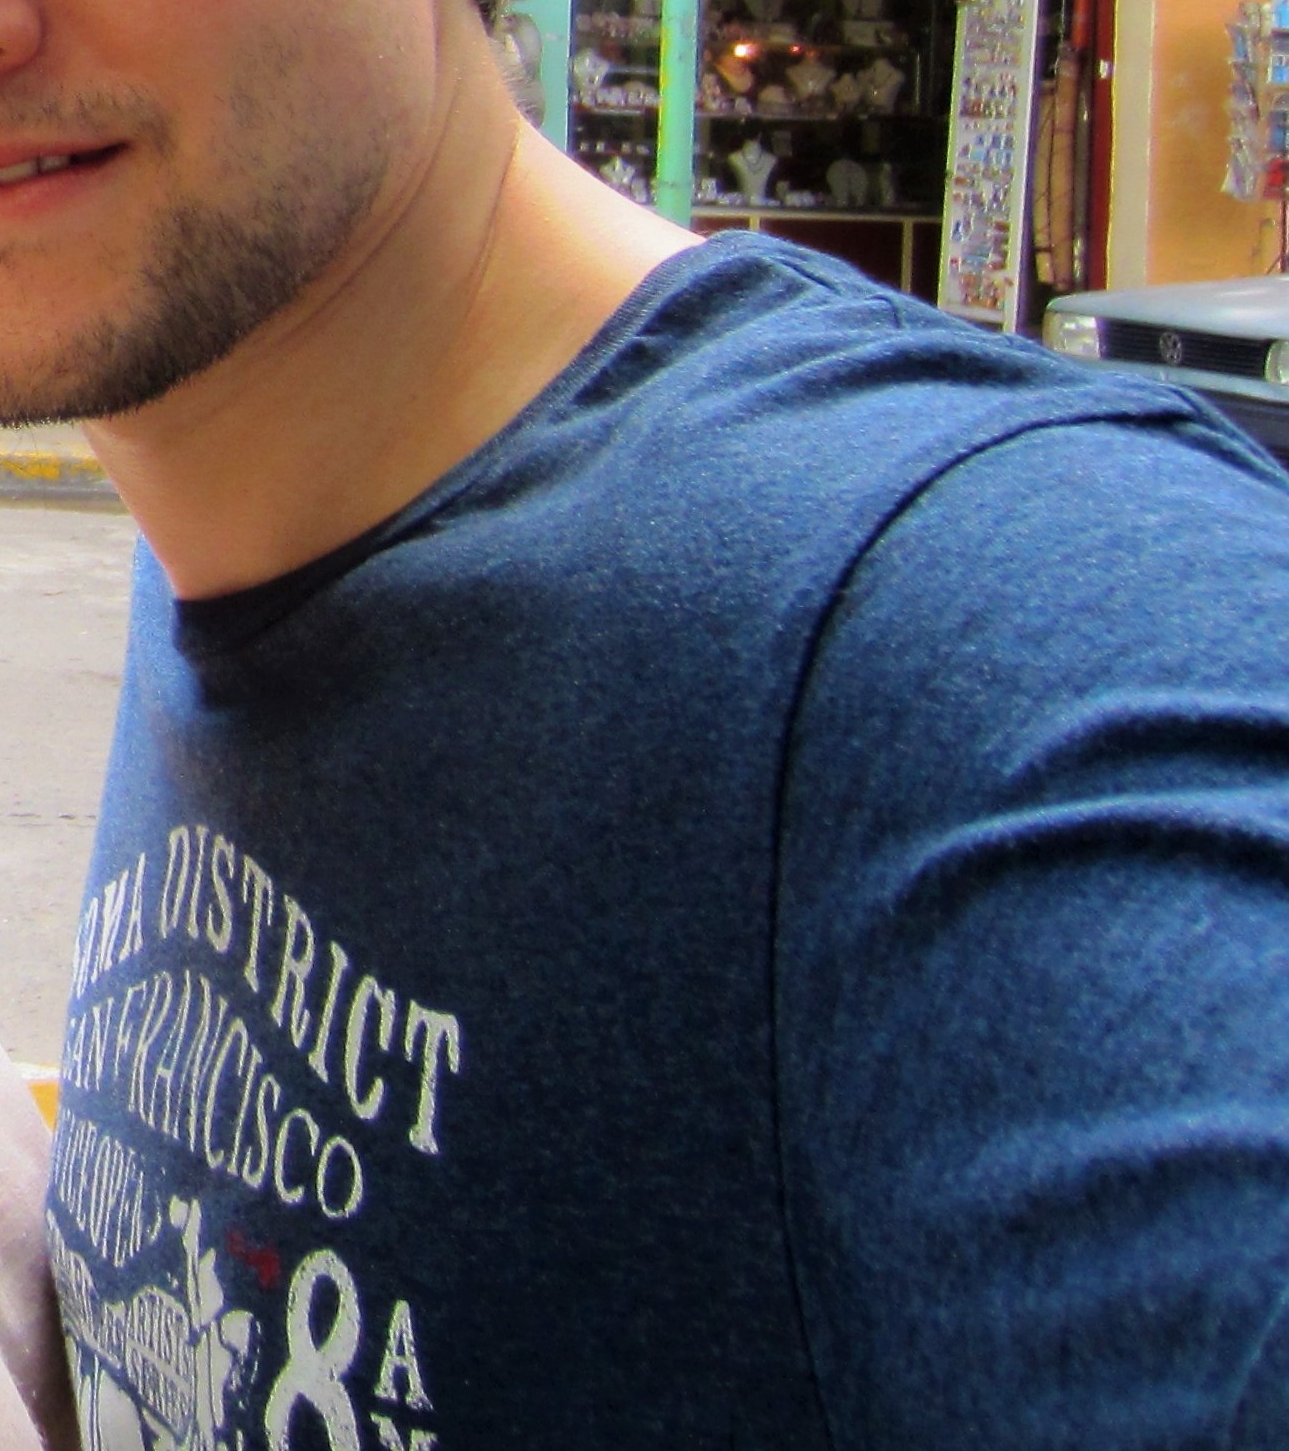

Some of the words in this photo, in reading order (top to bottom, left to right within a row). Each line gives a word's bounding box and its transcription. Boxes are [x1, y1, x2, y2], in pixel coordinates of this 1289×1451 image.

[114, 969, 364, 1220] FRANCISCO
[160, 824, 461, 1155] DISTRICT
[264, 1248, 362, 1451] 8
